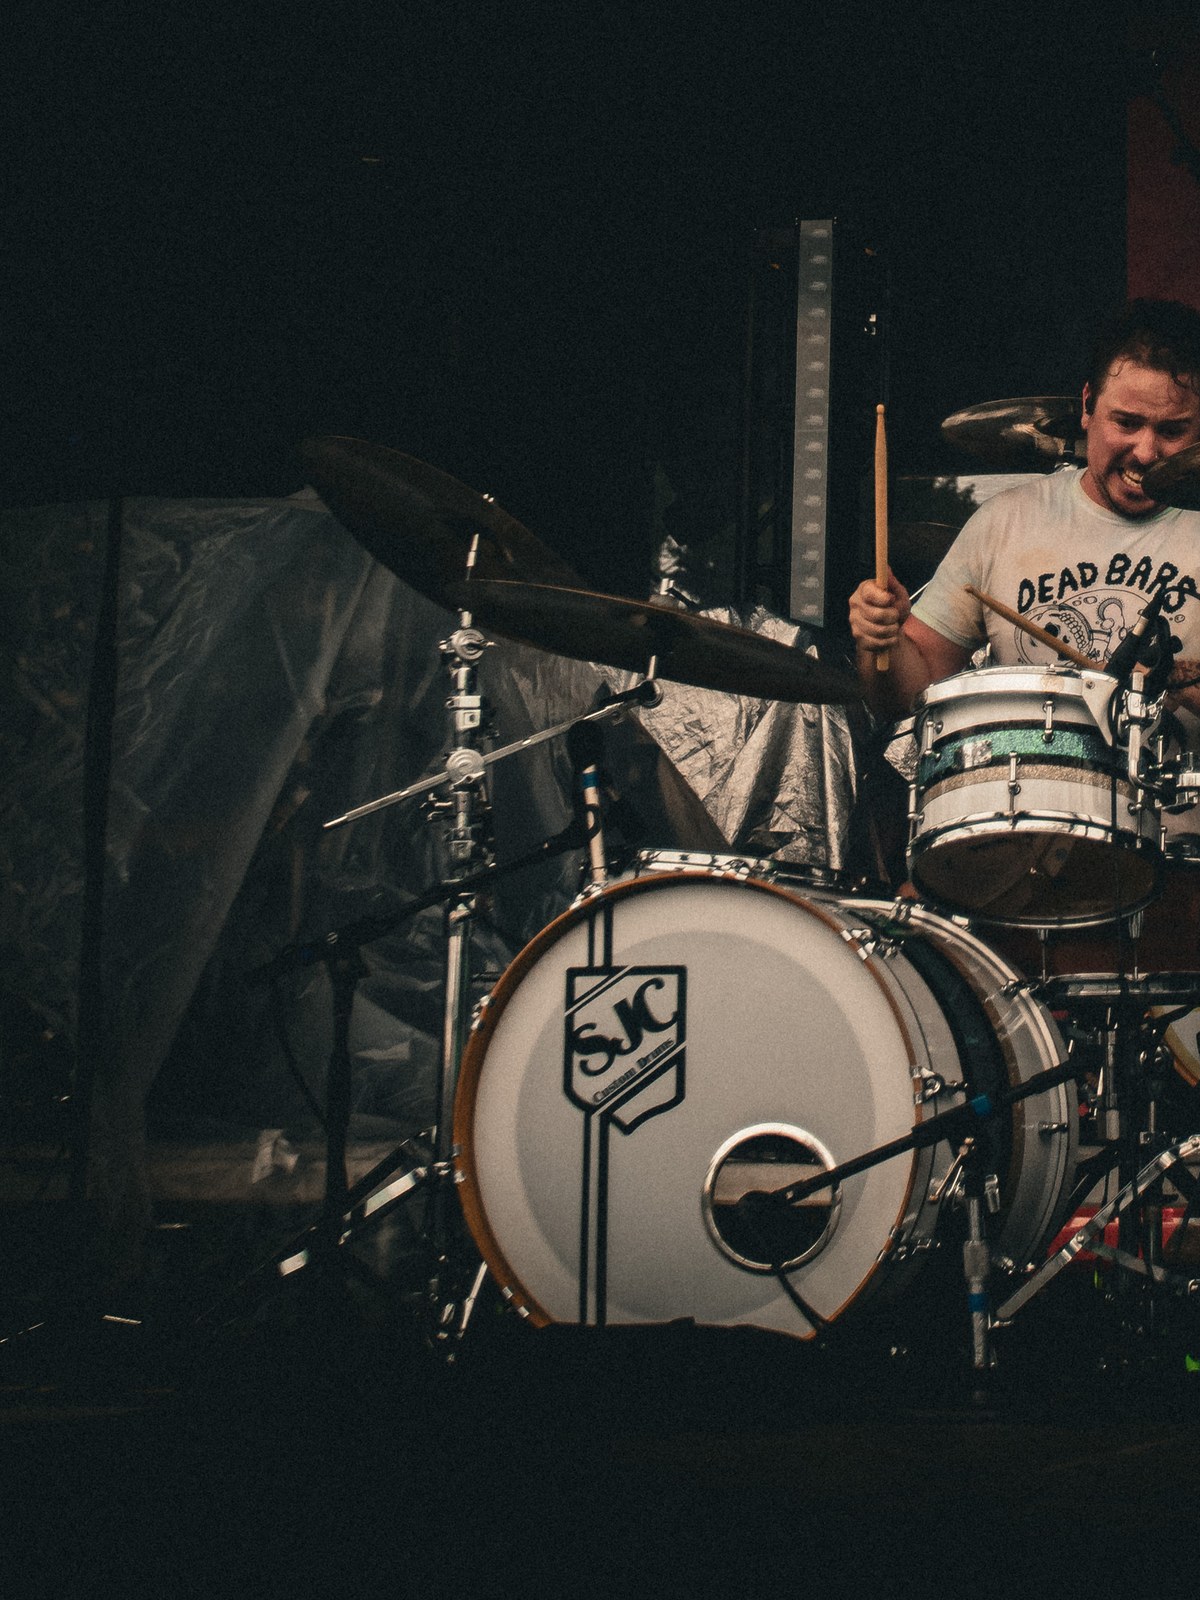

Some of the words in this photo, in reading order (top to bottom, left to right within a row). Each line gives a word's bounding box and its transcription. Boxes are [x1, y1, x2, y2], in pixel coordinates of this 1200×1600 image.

[1017, 561, 1098, 614] DEAD
[1104, 553, 1197, 613] BARS
[572, 977, 678, 1076] SJC
[593, 1067, 637, 1102] Custom
[636, 1037, 675, 1069] Drums
